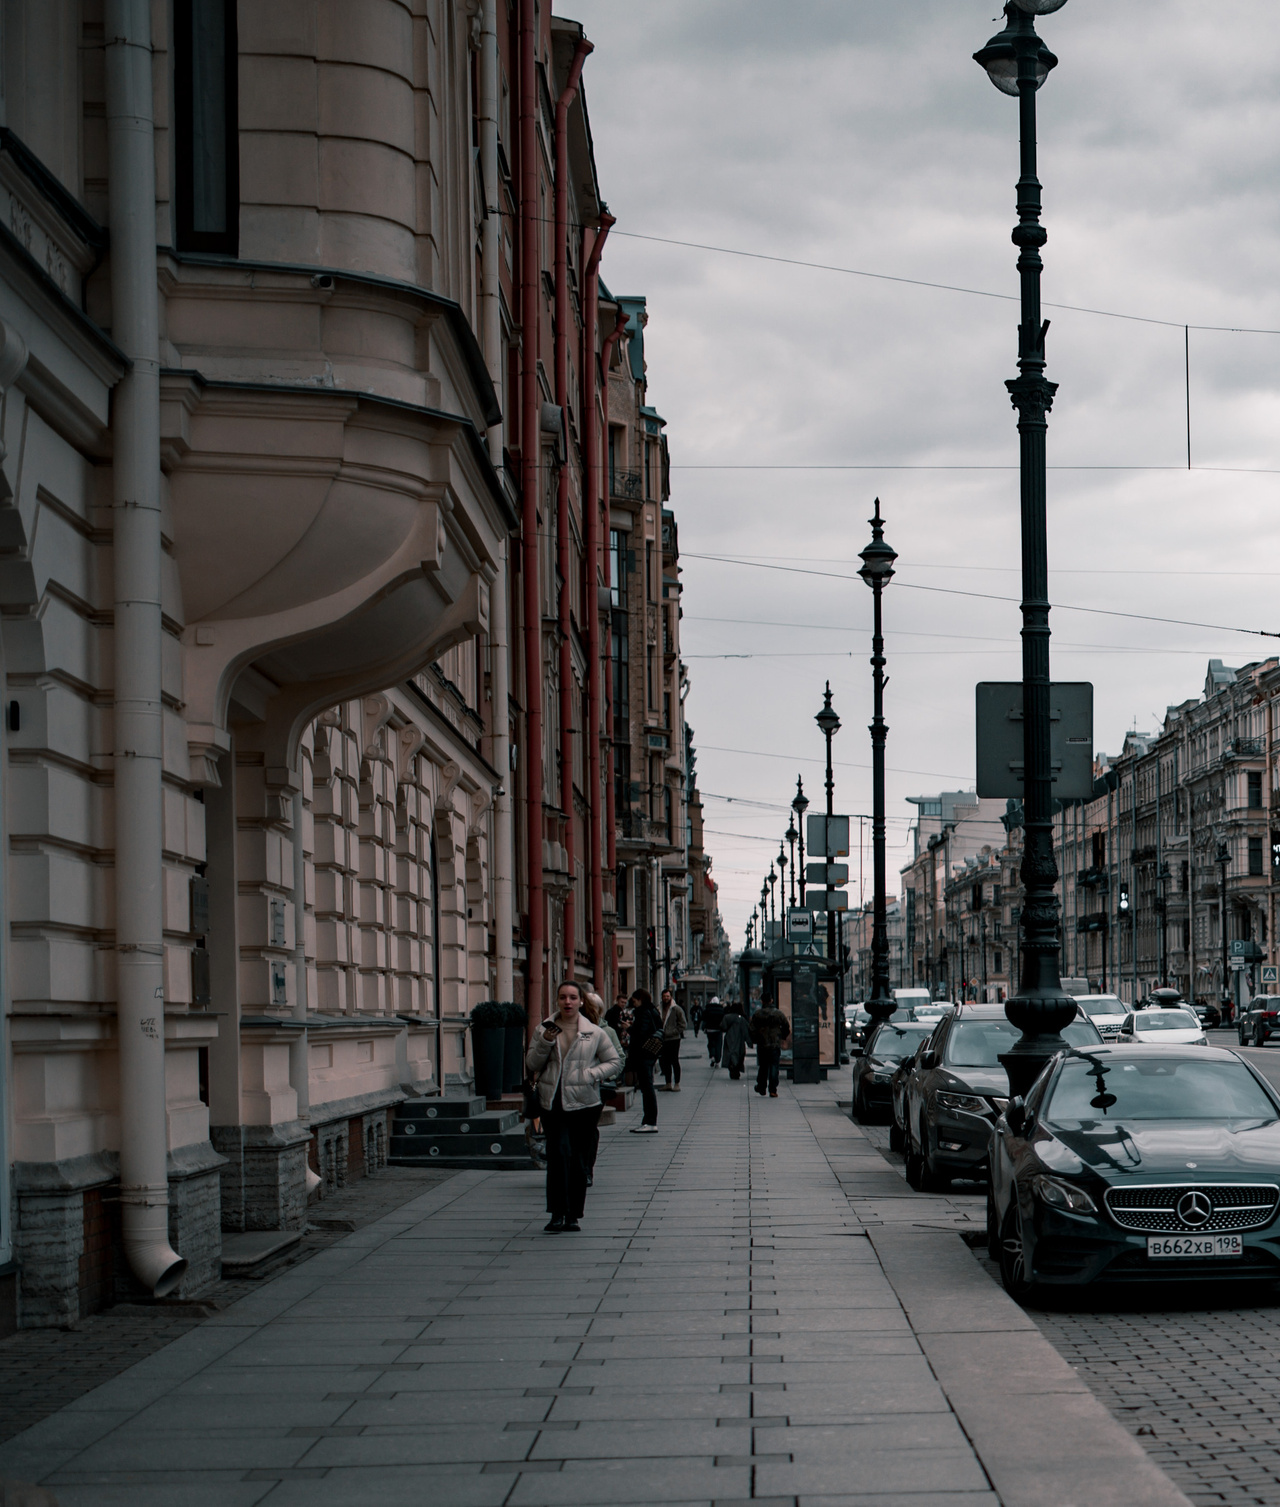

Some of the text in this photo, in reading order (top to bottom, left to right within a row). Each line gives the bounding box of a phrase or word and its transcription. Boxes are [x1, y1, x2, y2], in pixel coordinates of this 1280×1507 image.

[1234, 942, 1242, 953] P
[1153, 1237, 1238, 1254] В662ХВ 198
